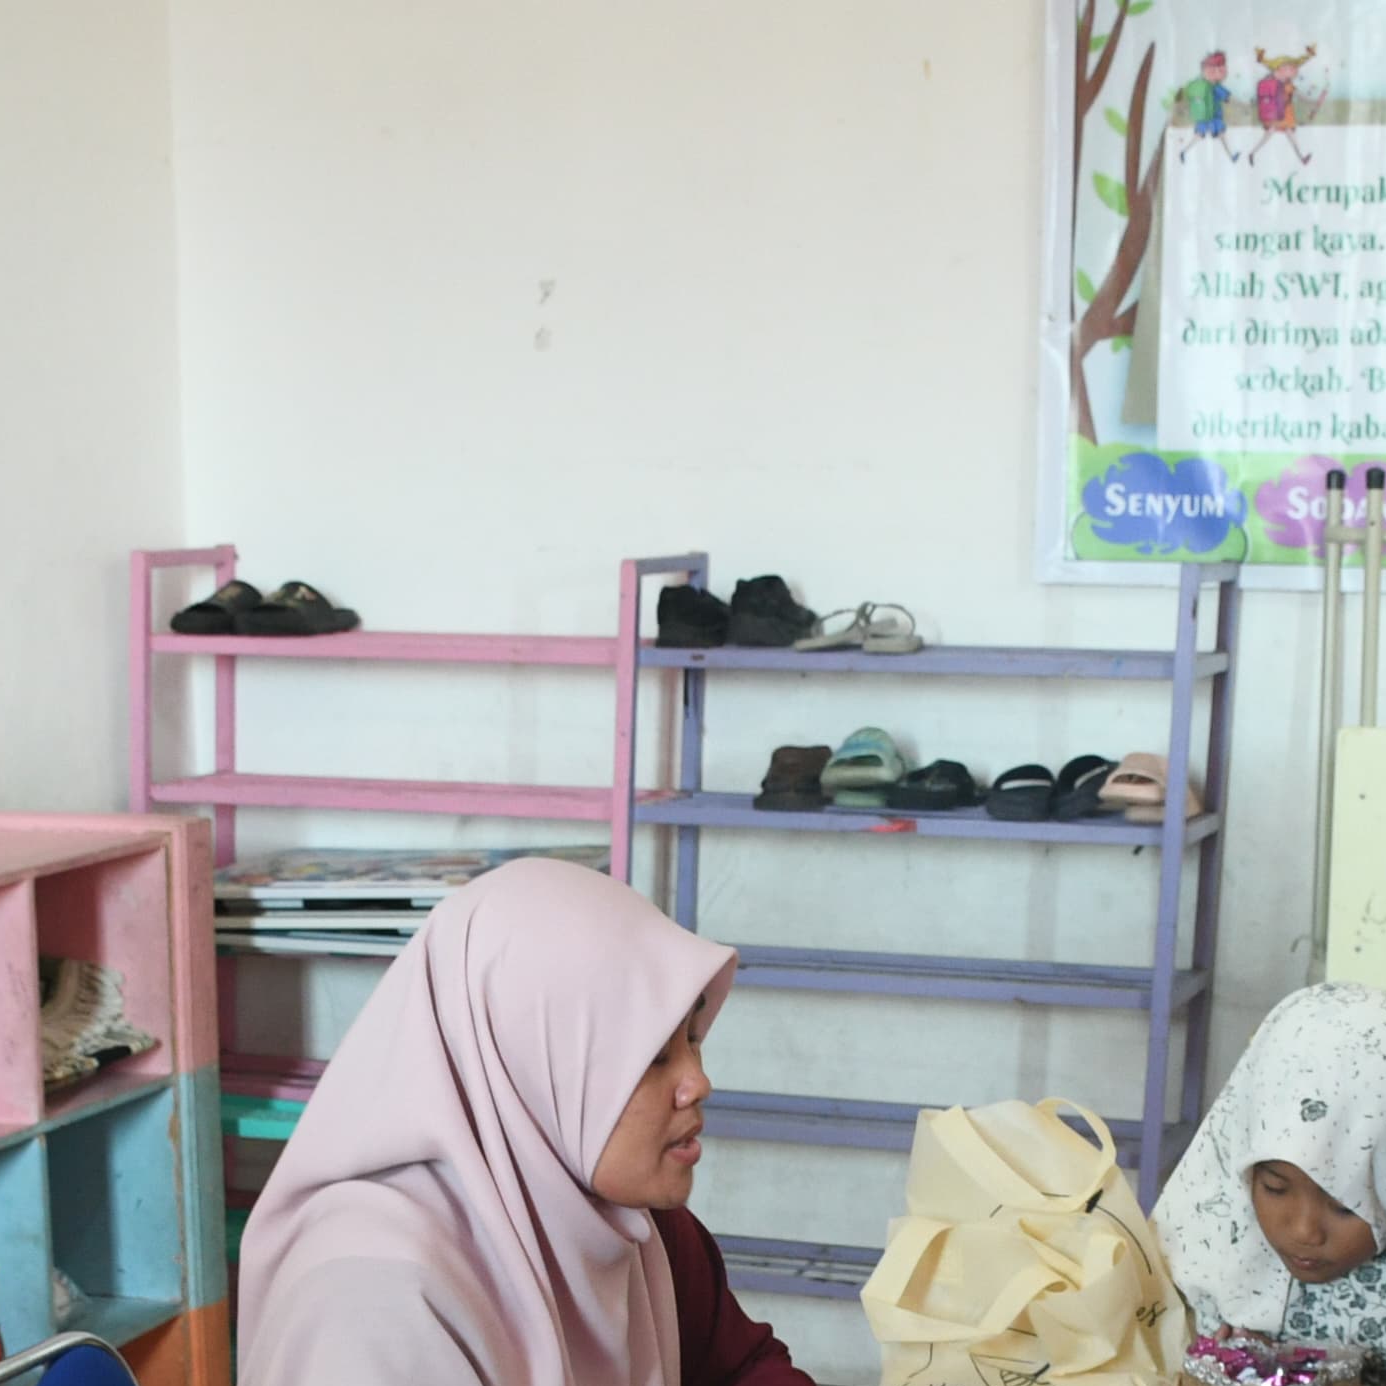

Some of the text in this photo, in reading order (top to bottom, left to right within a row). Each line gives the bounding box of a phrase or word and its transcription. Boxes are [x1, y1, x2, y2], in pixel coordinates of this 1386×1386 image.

[1214, 229, 1303, 258] sangat
[1190, 272, 1265, 301] Allah
[1182, 320, 1237, 346] dari
[1244, 320, 1338, 352] dirinya
[1193, 413, 1321, 444] diberikan
